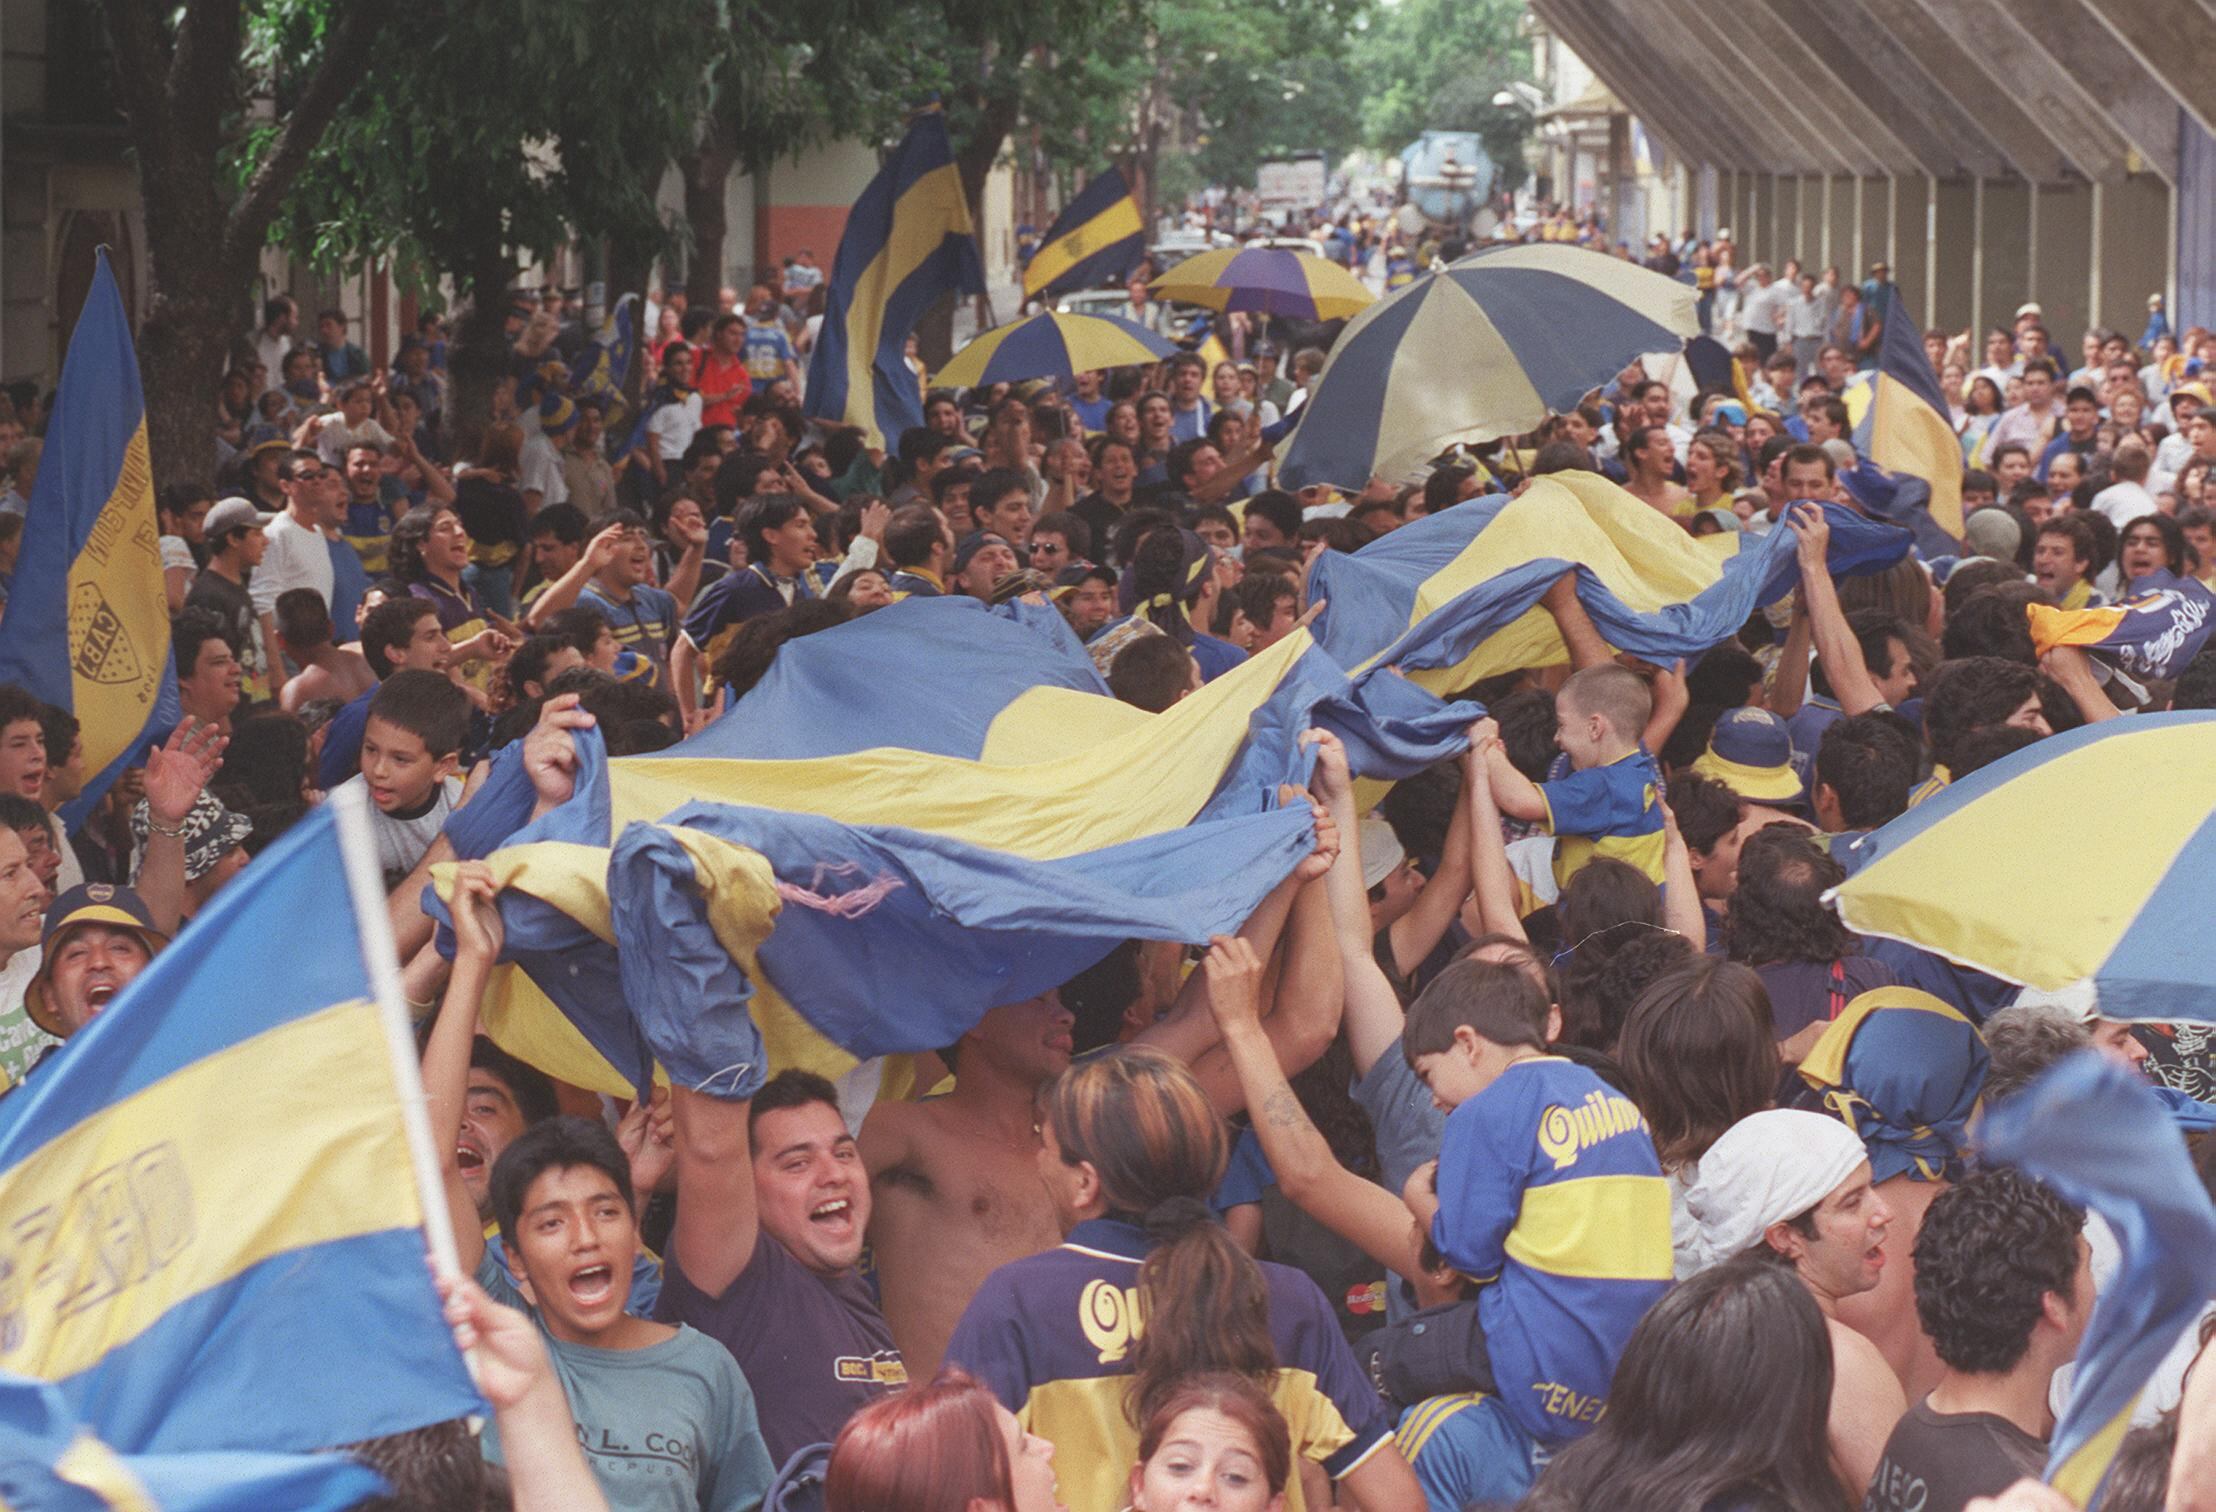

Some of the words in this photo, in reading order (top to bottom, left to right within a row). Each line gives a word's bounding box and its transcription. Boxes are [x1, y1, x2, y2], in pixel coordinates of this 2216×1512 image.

[1537, 1089, 1651, 1171] Quilm
[1078, 1278, 1150, 1365] Qu
[601, 1428, 630, 1452] L.
